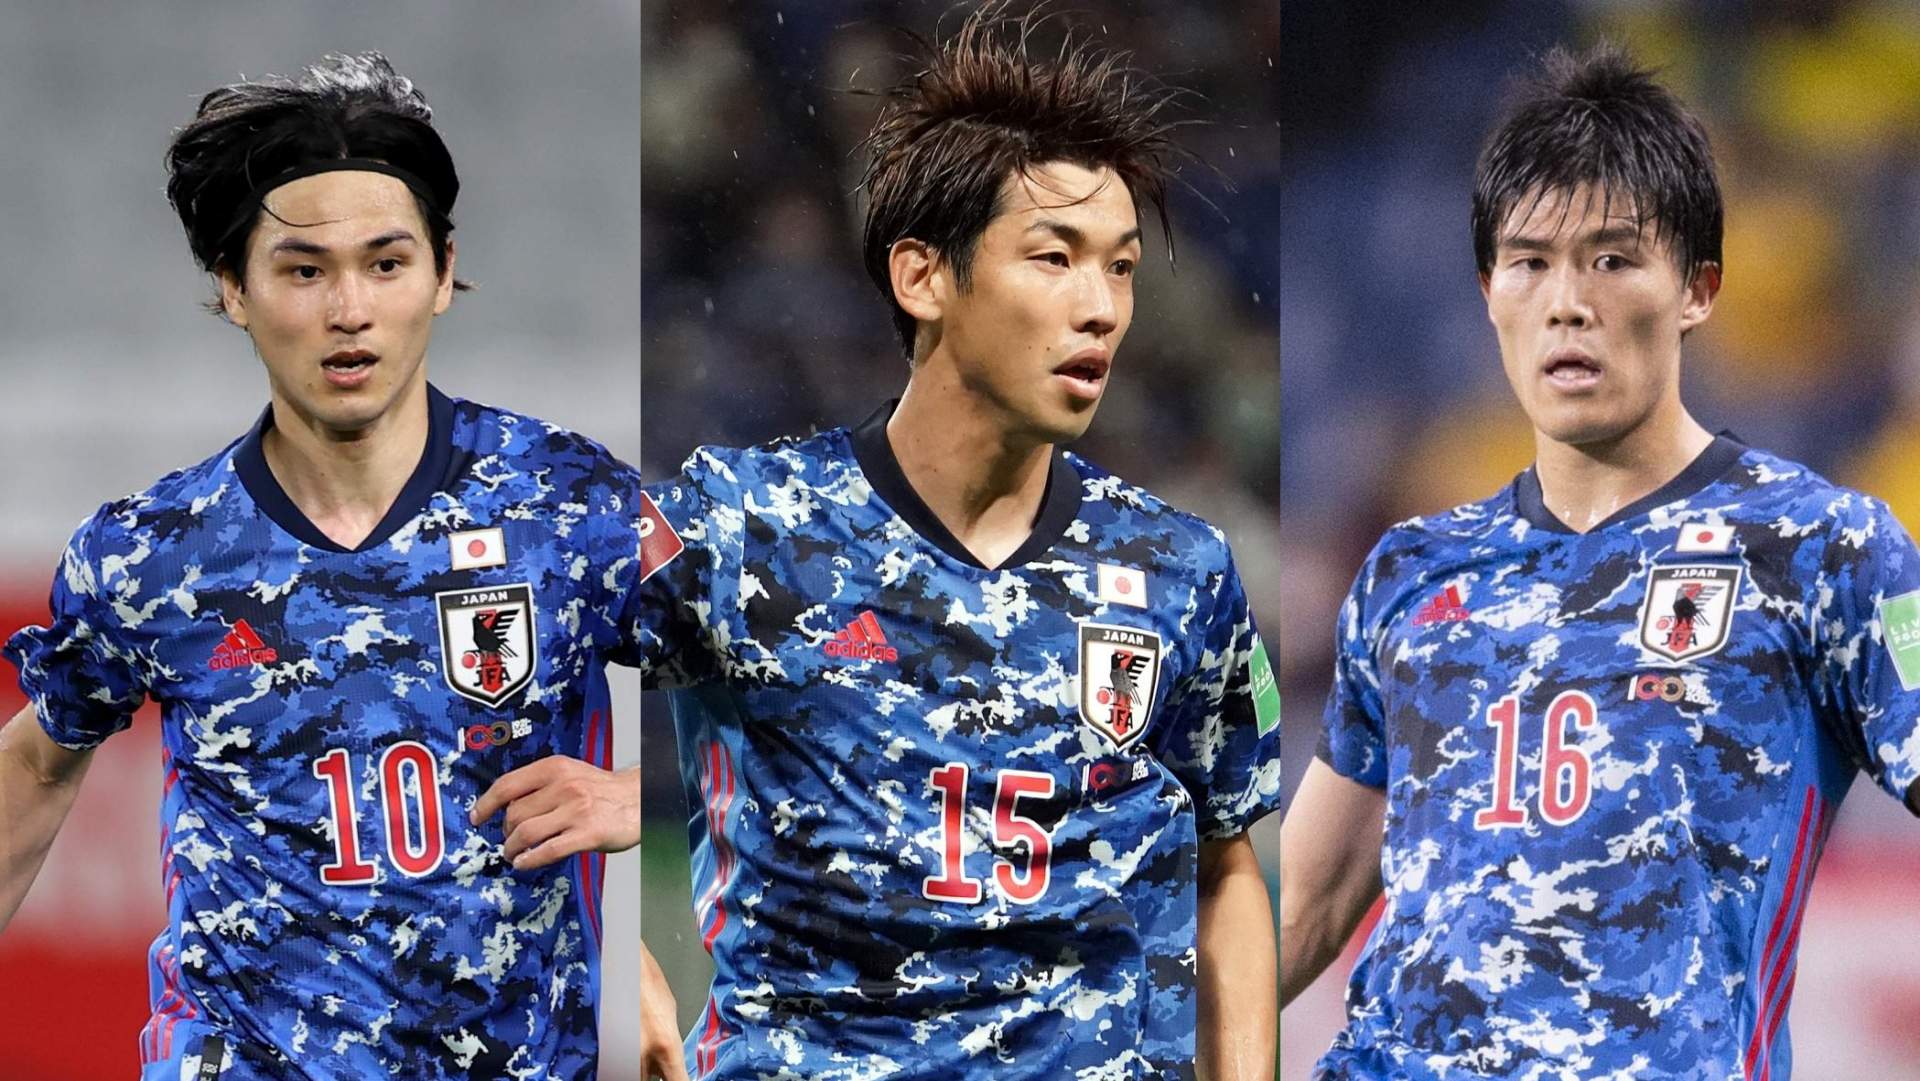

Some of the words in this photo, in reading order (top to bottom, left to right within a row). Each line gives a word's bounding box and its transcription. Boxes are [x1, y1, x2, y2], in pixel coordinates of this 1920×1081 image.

[1670, 568, 1717, 578] JAPAN
[461, 591, 509, 605] JAPAN
[1103, 630, 1144, 646] JAPAN
[1660, 632, 1698, 648] JFA
[208, 648, 278, 672] adidas
[824, 641, 898, 663] adidas
[473, 664, 512, 688] JFA
[1105, 706, 1134, 730] JFA
[1475, 691, 1597, 830] 16
[314, 741, 444, 885] 10
[922, 762, 1055, 904] 15
